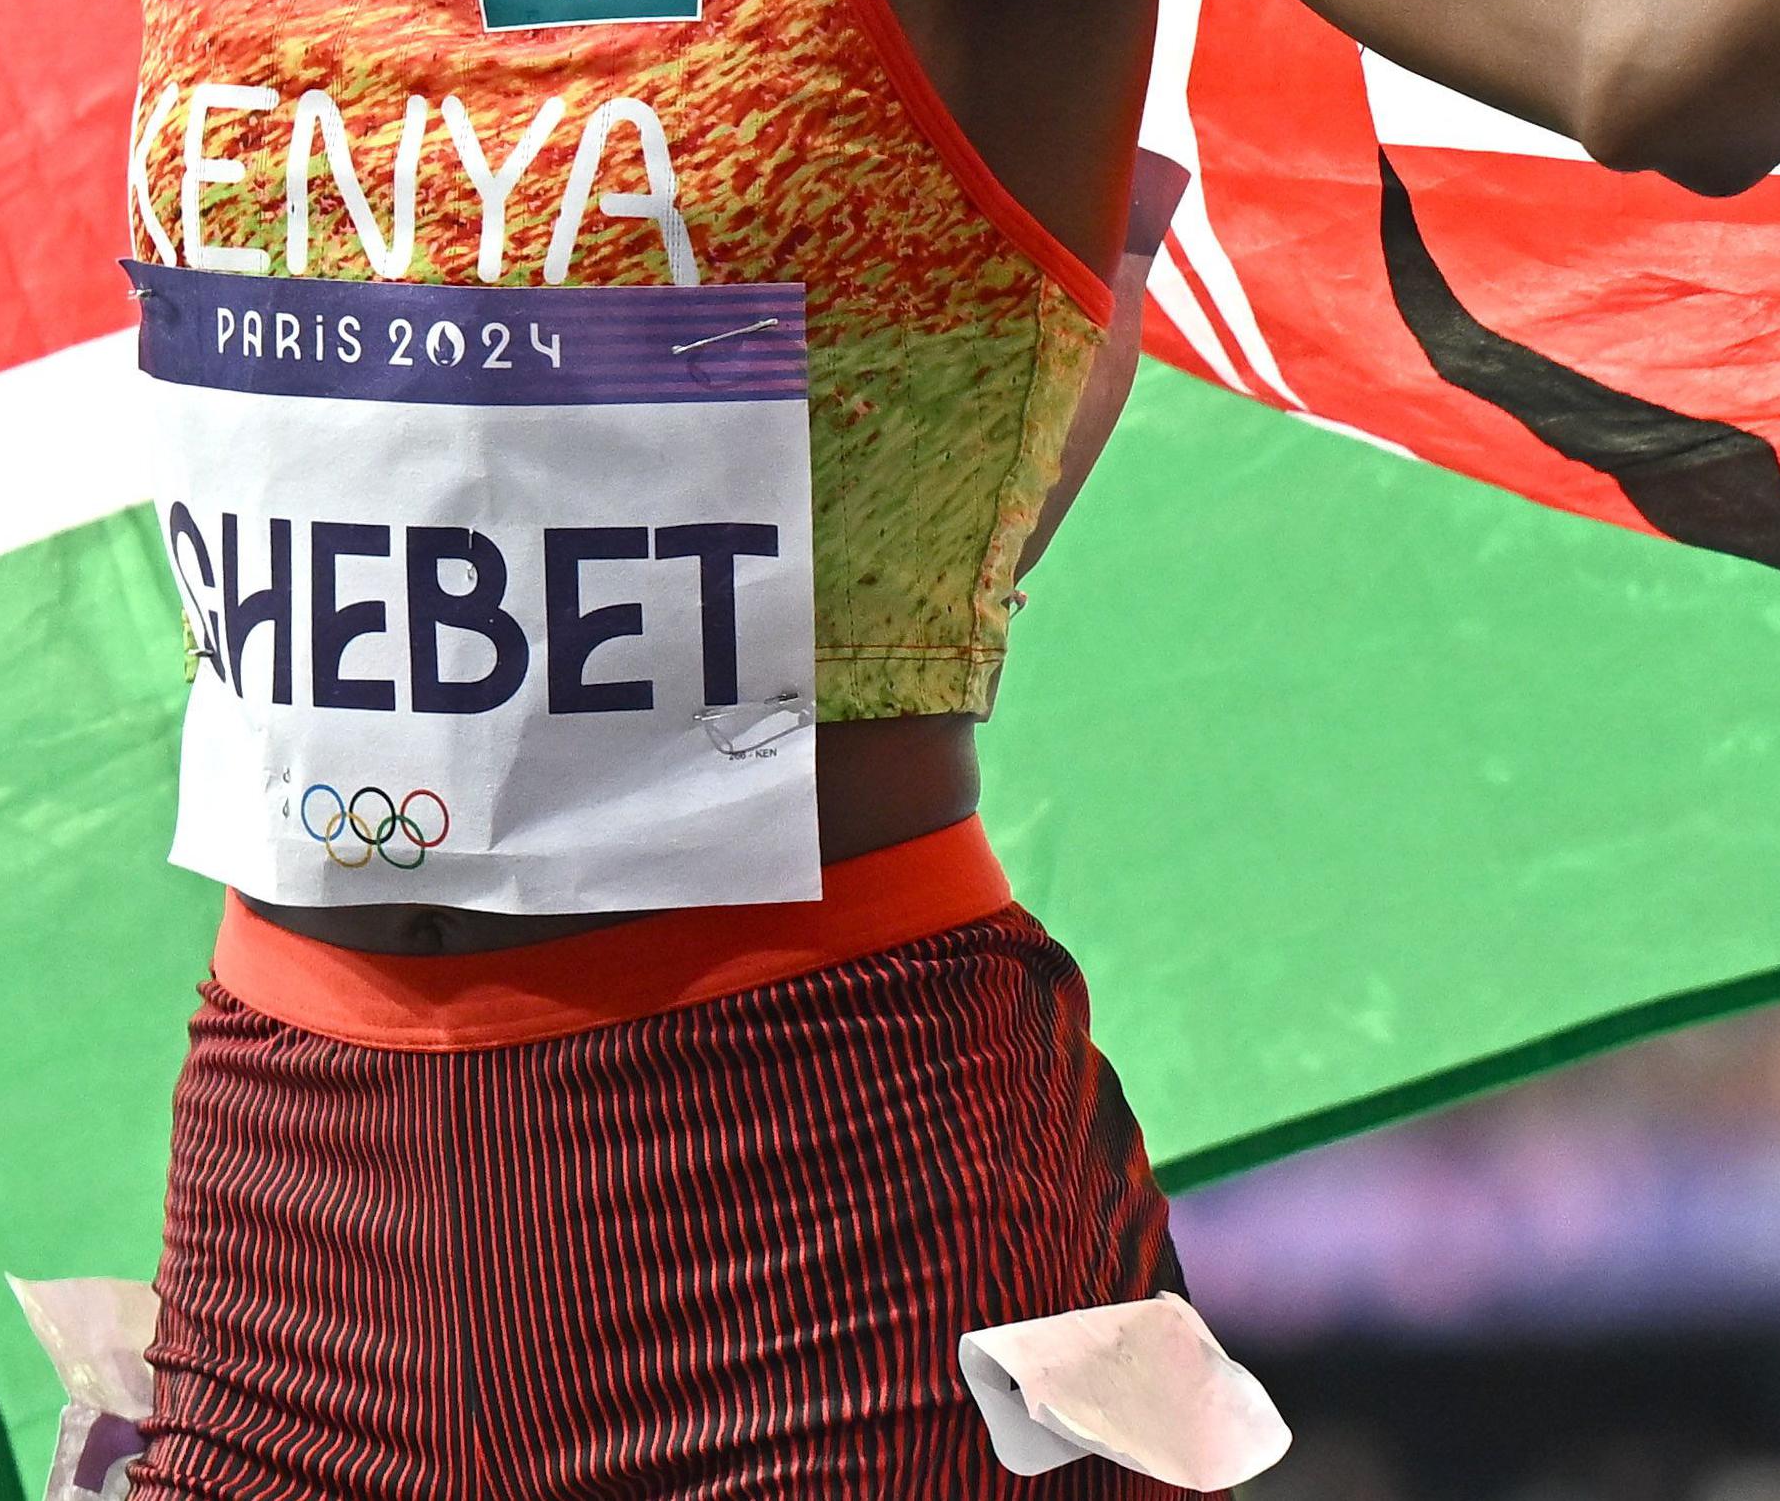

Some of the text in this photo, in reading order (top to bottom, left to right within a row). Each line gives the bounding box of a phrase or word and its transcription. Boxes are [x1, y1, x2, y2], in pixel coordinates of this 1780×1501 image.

[128, 81, 699, 285] KENYA
[388, 318, 561, 369] 2024
[170, 501, 779, 714] CHEBET
[755, 748, 778, 758] KEN
